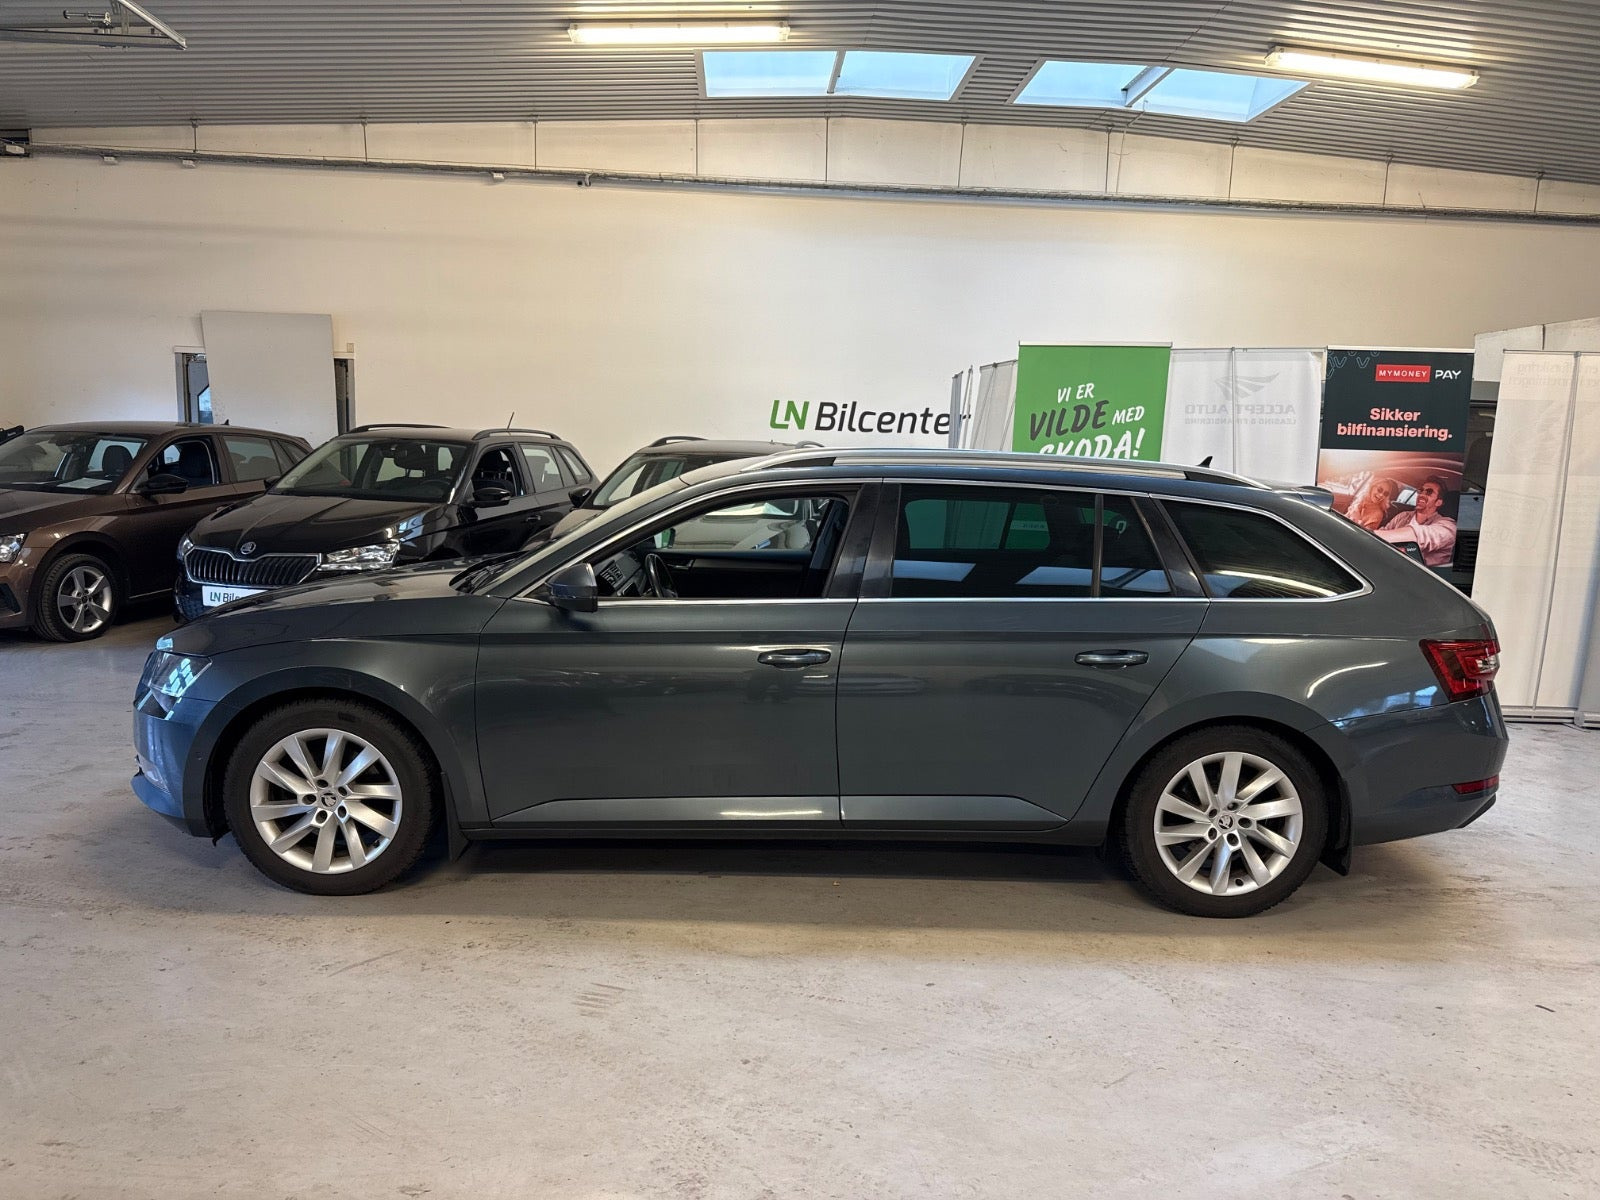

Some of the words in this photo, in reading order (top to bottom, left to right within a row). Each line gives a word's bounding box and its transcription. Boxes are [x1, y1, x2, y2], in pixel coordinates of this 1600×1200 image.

[1378, 369, 1428, 378] MYMONEY
[1435, 369, 1462, 380] PAY
[1057, 386, 1072, 404] VI
[1075, 382, 1095, 400] ER
[769, 399, 810, 430] LN
[1029, 399, 1110, 441] VILDE
[1111, 405, 1145, 425] MED
[1369, 407, 1421, 421] Sikker
[1336, 422, 1453, 441] bilfinansiering.
[210, 591, 221, 602] LN
